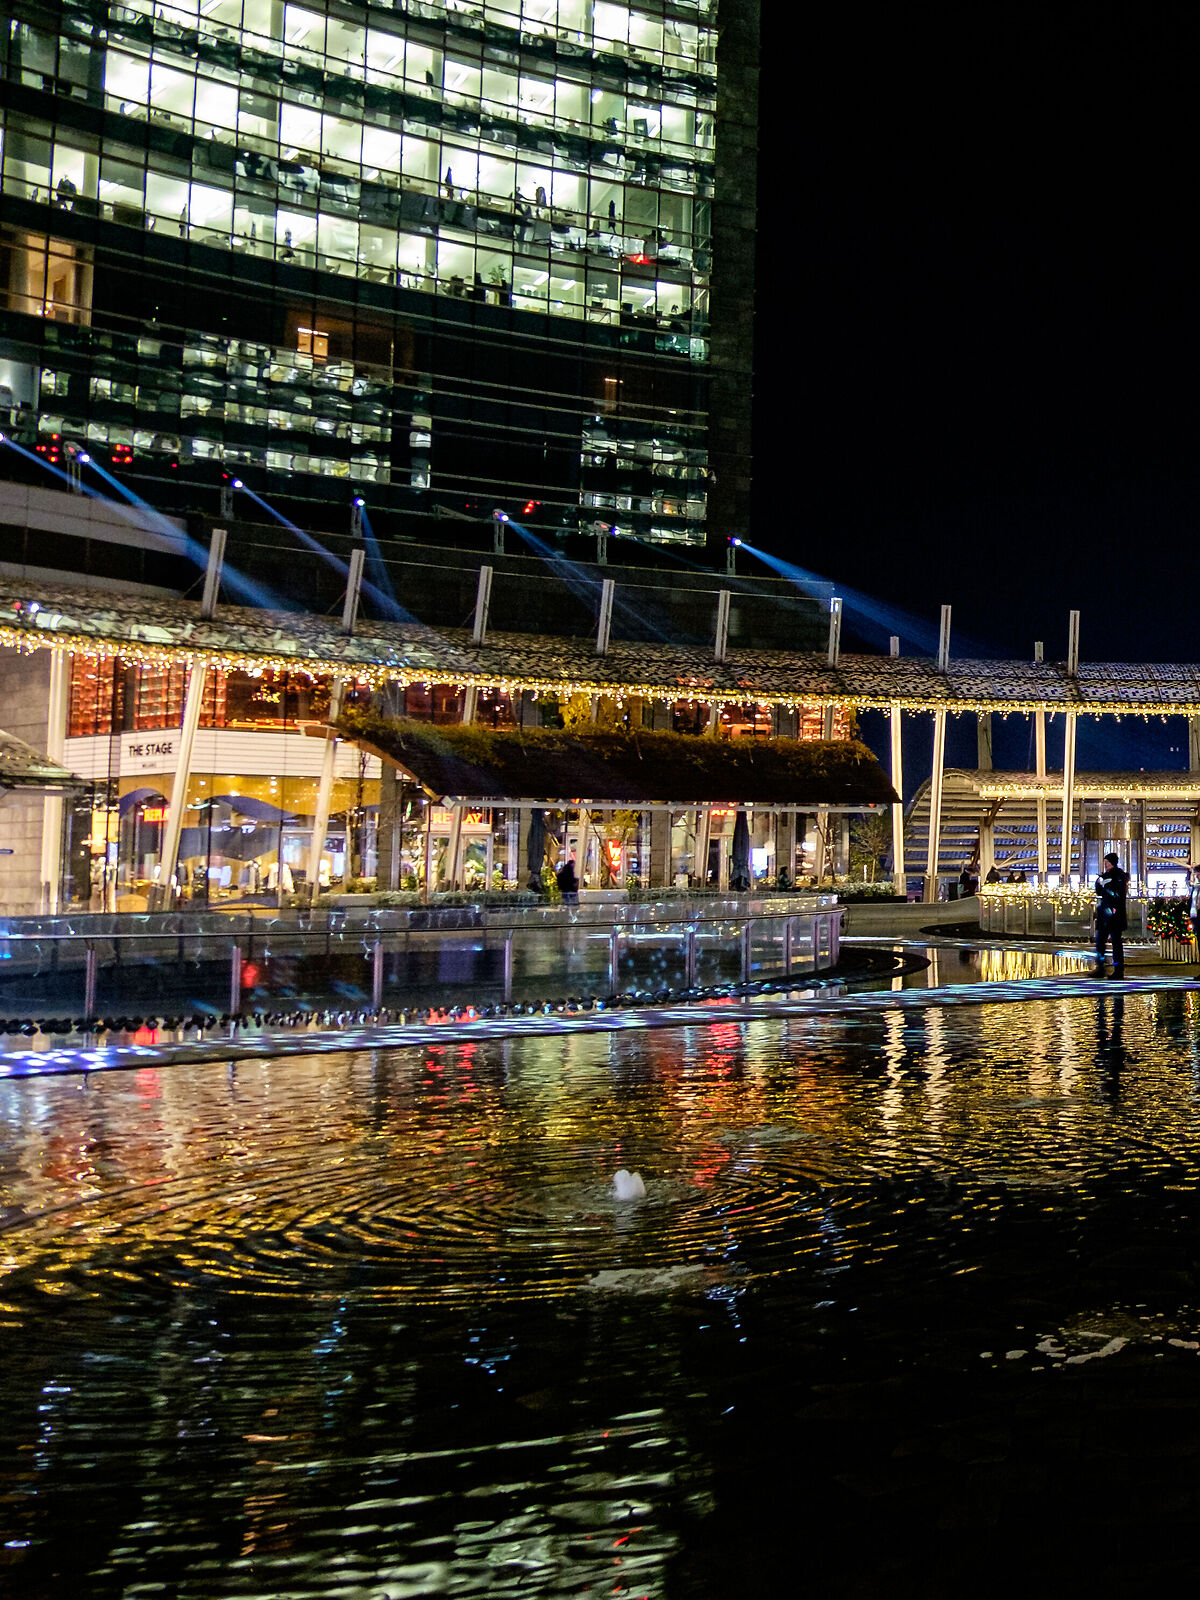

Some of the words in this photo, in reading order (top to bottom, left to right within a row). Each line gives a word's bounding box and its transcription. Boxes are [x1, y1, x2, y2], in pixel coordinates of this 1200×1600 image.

[129, 745, 143, 757] THE
[146, 742, 172, 756] STAGE
[432, 812, 483, 824] REAY
